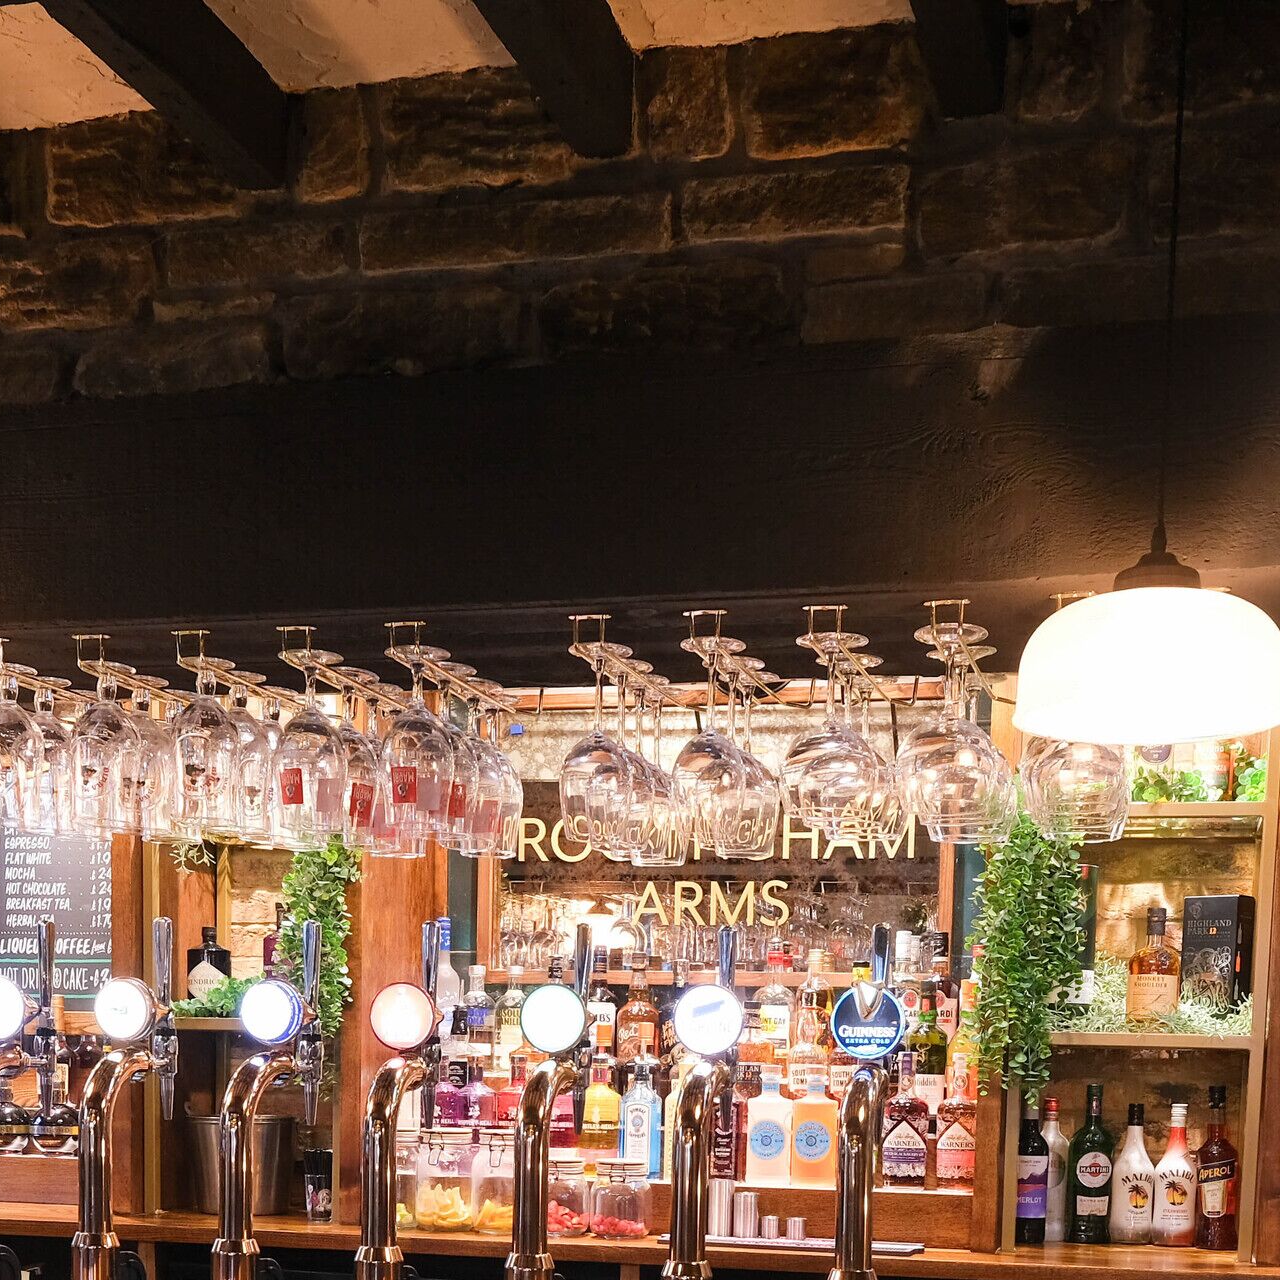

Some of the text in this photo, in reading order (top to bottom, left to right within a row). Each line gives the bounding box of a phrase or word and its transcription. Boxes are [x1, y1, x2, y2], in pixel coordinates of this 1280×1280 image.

[5, 837, 50, 850] ESPRESSO
[517, 815, 916, 863] ROHAM
[5, 853, 25, 865] FLAT
[26, 853, 52, 865] WHITE
[5, 867, 36, 880] MOCHA
[6, 882, 21, 895] HOT
[22, 882, 67, 895] CHOCOLATE
[6, 898, 51, 911] BREAKFAST
[54, 898, 70, 911] TEA
[632, 880, 789, 927] ARMS
[6, 914, 37, 928] HERBAL
[1187, 919, 1232, 928] HIGHLAND
[1187, 927, 1208, 936] PARK
[0, 938, 39, 954] LIQUEU
[55, 938, 91, 955] OFFEE
[22, 967, 39, 989] DRI
[63, 967, 89, 990] CAKE
[1134, 981, 1168, 989] SHOULDER
[1136, 975, 1166, 983] MONKEY
[839, 1025, 897, 1038] GUINNESS
[1080, 1166, 1110, 1175] MARTINI
[1198, 1165, 1232, 1180] APEROL
[1121, 1172, 1154, 1187] MALIB
